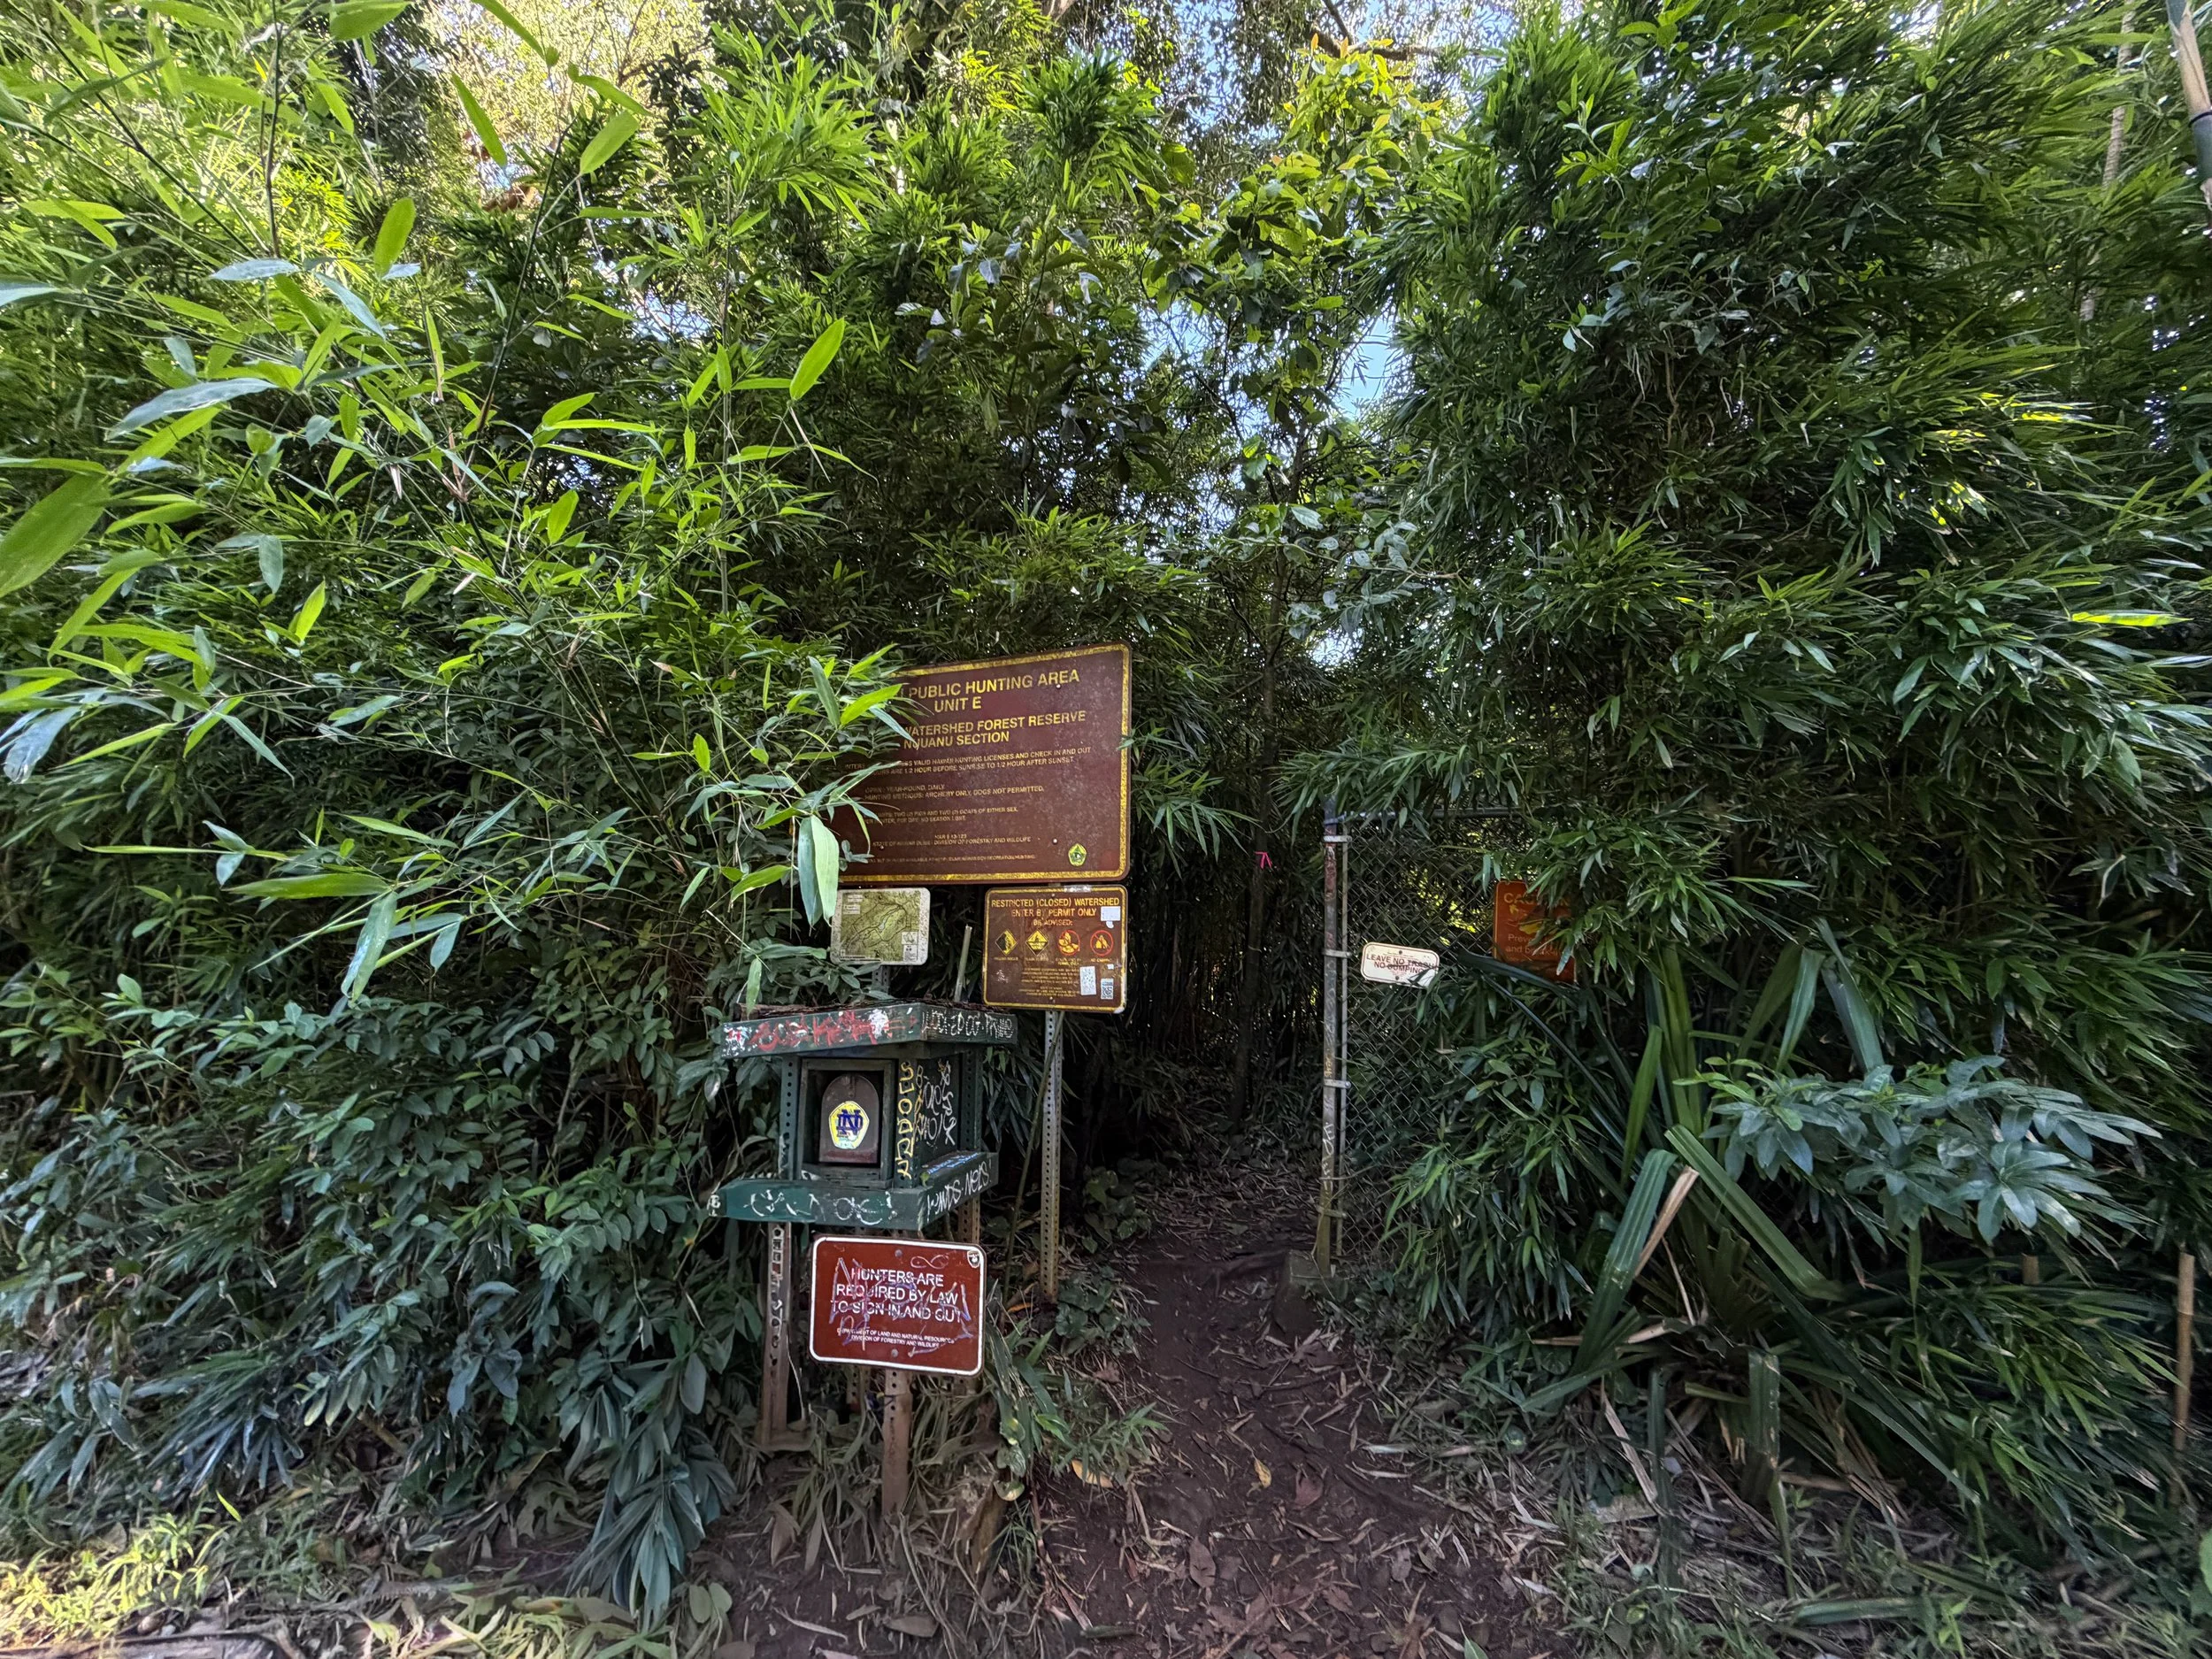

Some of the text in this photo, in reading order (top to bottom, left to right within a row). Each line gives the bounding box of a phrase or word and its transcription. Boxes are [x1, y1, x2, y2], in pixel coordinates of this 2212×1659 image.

[909, 683, 962, 699] PUBLIC
[965, 674, 1033, 695] HUNTING
[1038, 669, 1080, 686] AREA
[933, 696, 982, 713] UNIT E
[977, 716, 1025, 731] FOREST
[1028, 710, 1087, 726] RESERVE
[956, 731, 1010, 747] SECTION
[1036, 898, 1071, 908] (CLOSED)
[1074, 897, 1120, 906] WATERSHED
[1048, 908, 1076, 917] PERMIT
[1078, 908, 1097, 917] ONLY
[1366, 954, 1392, 963] LEAVE
[850, 1268, 945, 1287] HUNTERS ARE
[836, 1284, 959, 1305] REQUIRED BY LAW
[830, 1300, 963, 1324] TO SIGN IN AND OUT
[902, 1333, 924, 1341] NATURAL
[918, 1340, 941, 1348] WILDLIFE
